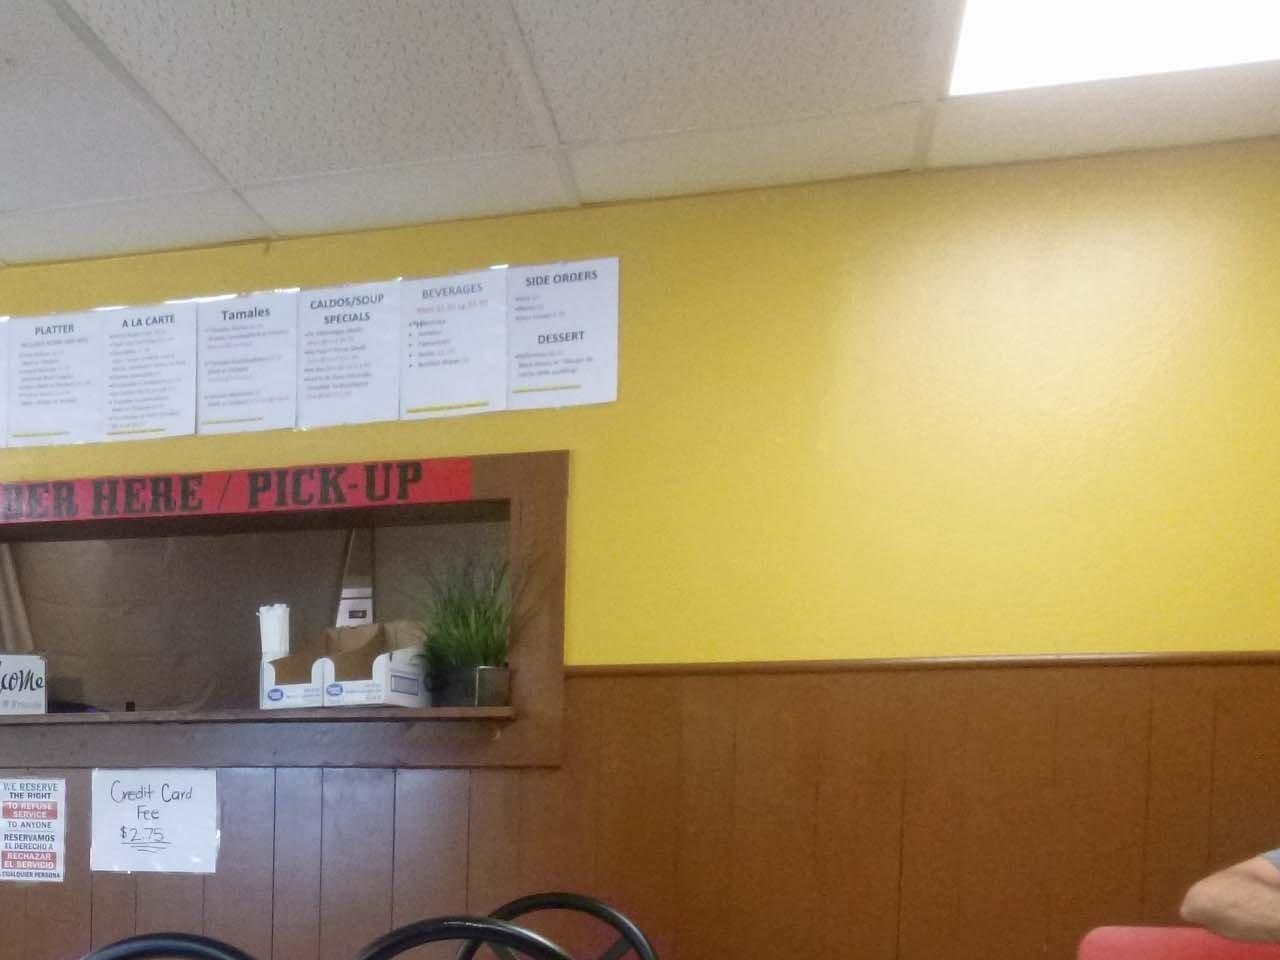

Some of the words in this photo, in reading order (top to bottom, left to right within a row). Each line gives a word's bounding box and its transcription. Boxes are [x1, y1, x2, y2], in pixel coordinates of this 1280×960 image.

[525, 274, 550, 287] SIDE
[553, 270, 598, 284] ORDERS
[422, 282, 484, 299] BEVERAGES
[310, 293, 384, 310] CALDOS/SOUP
[221, 306, 271, 321] Tamales
[324, 312, 371, 325] SPECIALS
[122, 319, 129, 328] A
[131, 317, 142, 327] LA
[145, 314, 175, 326] CARTE
[34, 323, 75, 336] PLATTER
[538, 330, 585, 345] DESSERT
[92, 474, 203, 517] HERE
[247, 462, 424, 510] PICK-UP
[3, 782, 17, 792] WE
[21, 782, 59, 792] RESERVE
[110, 779, 153, 803] Credit
[161, 783, 193, 803] Card
[9, 792, 24, 800] THE
[27, 792, 52, 800] RIGHT
[8, 802, 18, 810] TO
[21, 802, 53, 810] REFUSE
[137, 805, 160, 820] Fee
[13, 810, 48, 818] SERVICE
[8, 821, 17, 829] TO
[20, 821, 52, 829] ANYONE
[3, 833, 55, 842] RESERVAMOS
[120, 826, 165, 842] $2.75
[5, 842, 13, 850] EL
[14, 842, 46, 850] DERECHO
[7, 852, 51, 860] RECHAZAR
[4, 860, 14, 868] EL
[16, 861, 54, 869] SERVICIO
